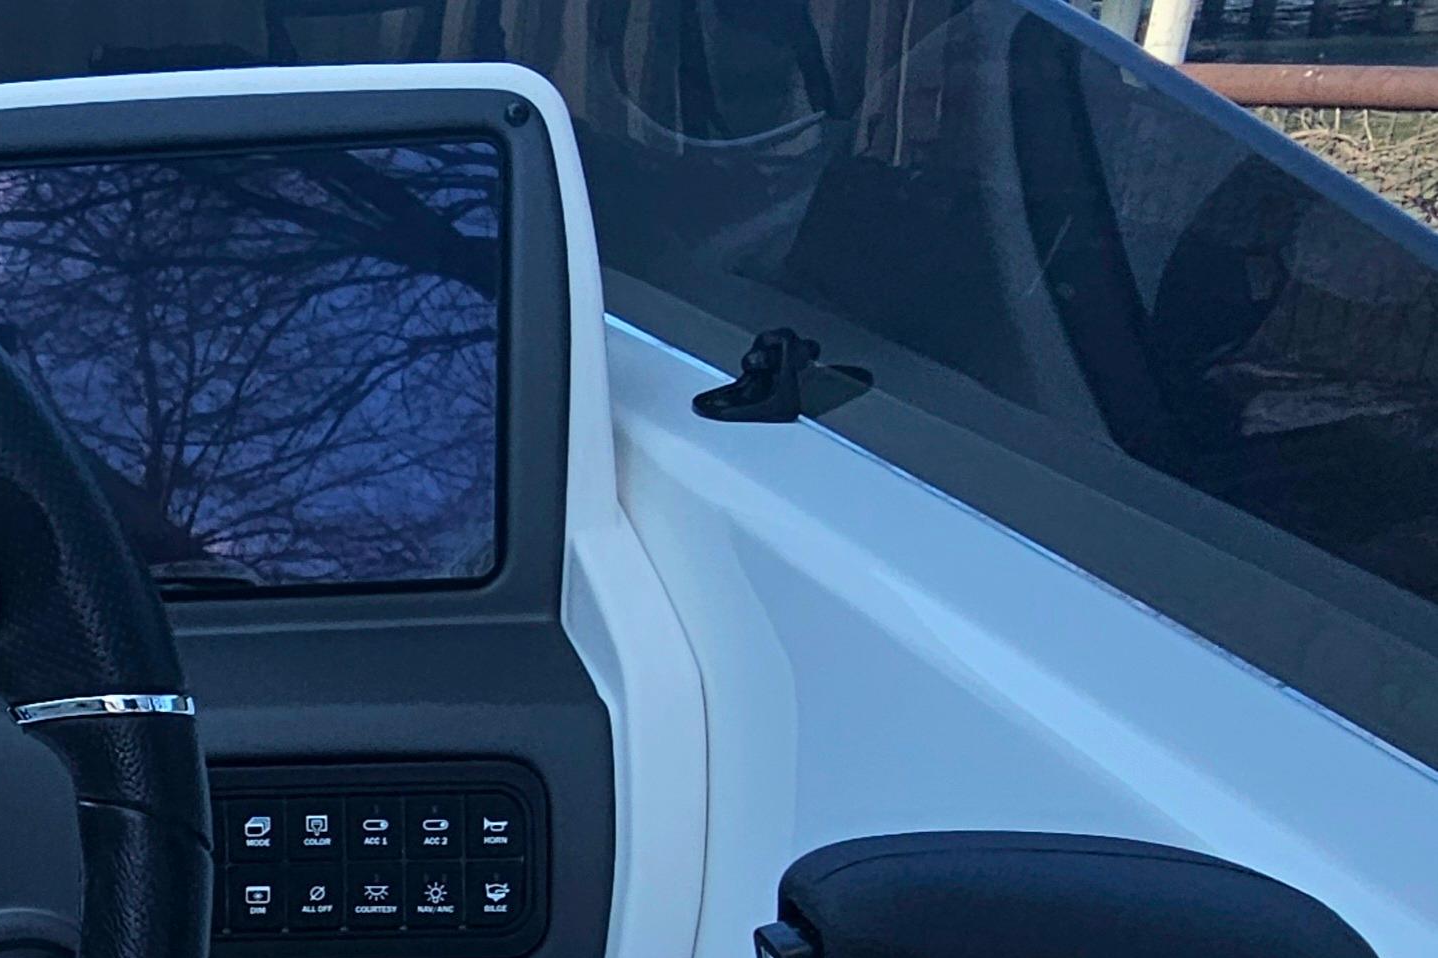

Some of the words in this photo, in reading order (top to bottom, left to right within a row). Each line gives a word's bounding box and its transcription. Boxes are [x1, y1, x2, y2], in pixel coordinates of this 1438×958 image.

[246, 838, 270, 847] MODE
[303, 838, 331, 846] COLOR
[363, 837, 380, 845] ACC
[382, 837, 388, 845] 1
[423, 836, 440, 845] ACC
[441, 836, 448, 845] 2
[483, 836, 508, 845] HORN
[249, 907, 267, 915] DIM
[302, 905, 316, 913] ALL
[317, 905, 333, 913] OFF
[355, 905, 397, 914] COURTESY
[417, 905, 454, 914] NAV/ANC
[483, 904, 508, 913] BILGE
